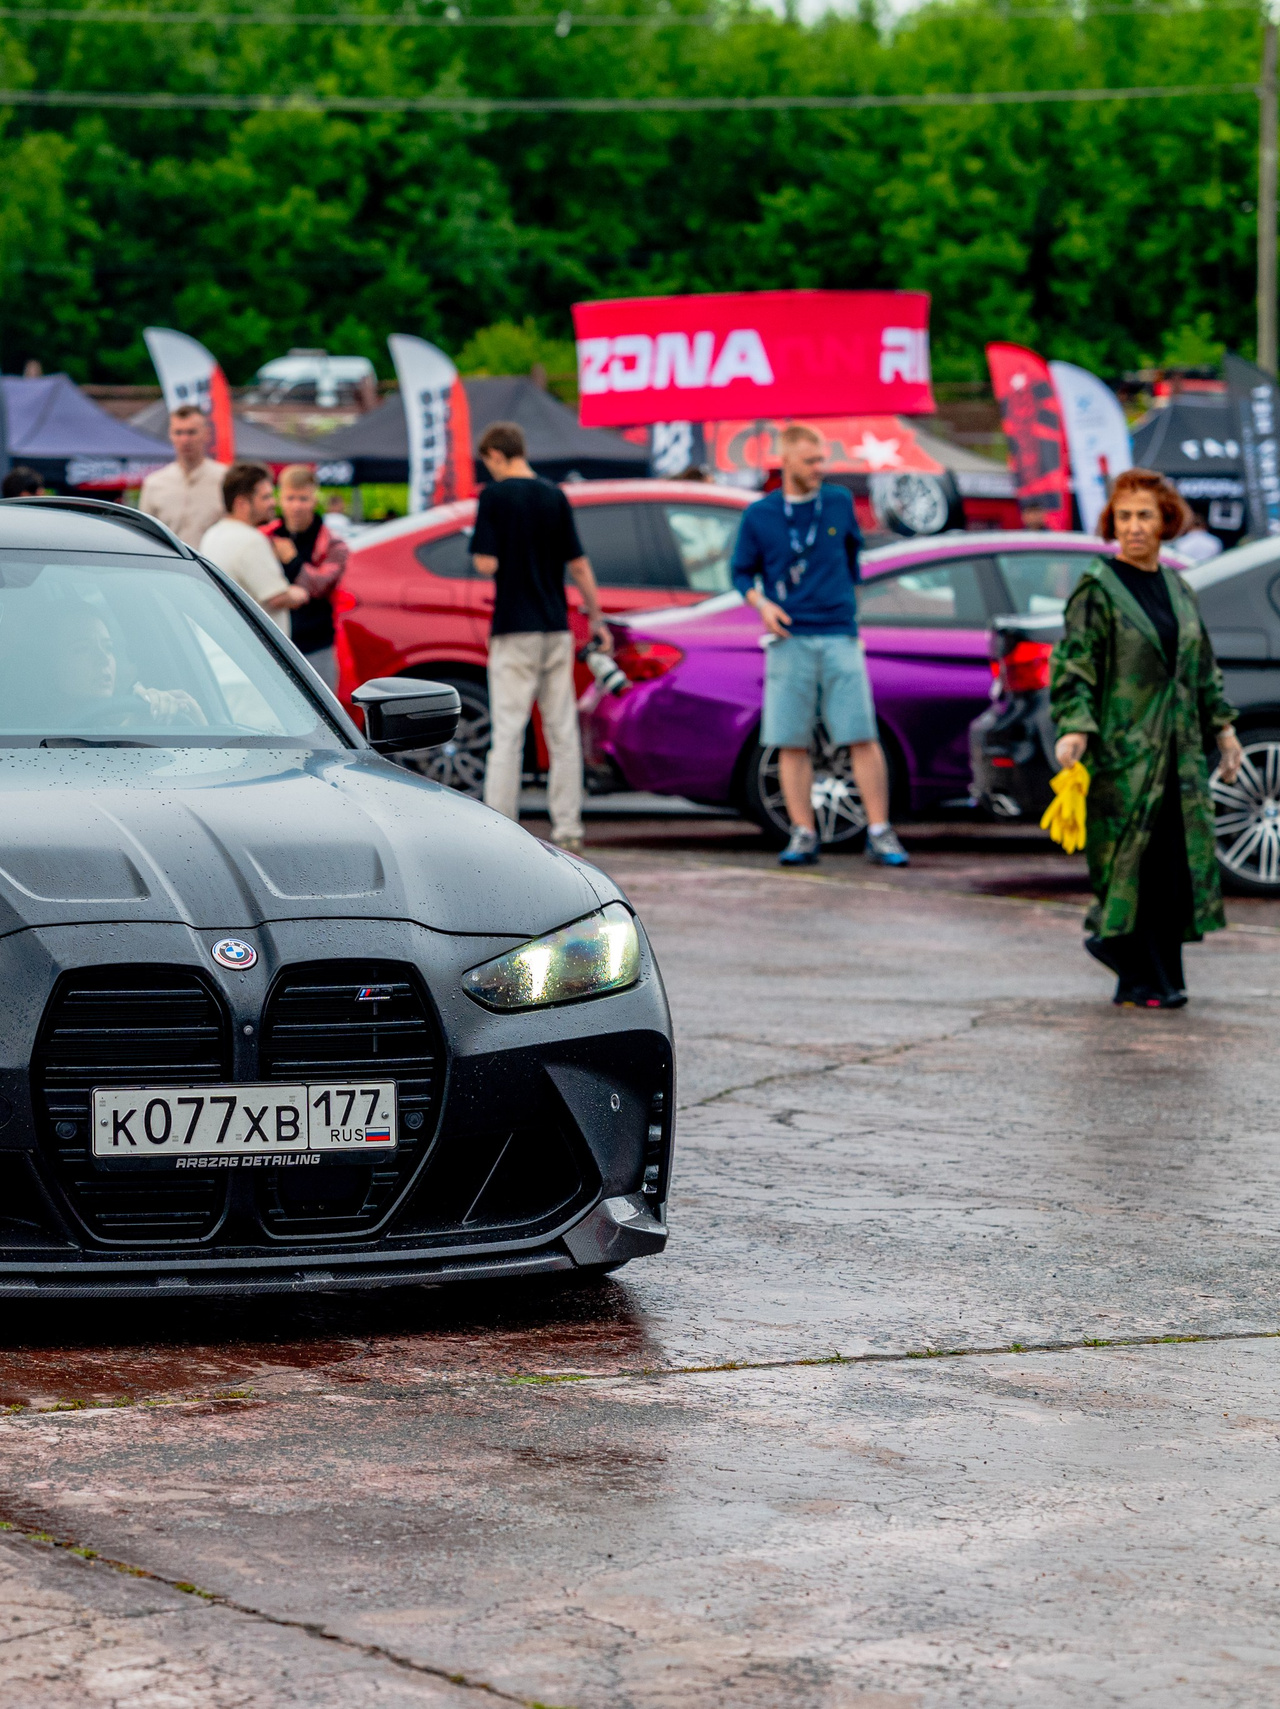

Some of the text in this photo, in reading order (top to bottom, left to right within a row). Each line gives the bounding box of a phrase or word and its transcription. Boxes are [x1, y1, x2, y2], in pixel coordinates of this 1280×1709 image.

[577, 328, 775, 395] ZONA
[112, 1095, 300, 1146] K077XB
[312, 1088, 381, 1127] 177
[330, 1128, 364, 1142] RUS
[175, 1153, 321, 1169] ARSZAG DETAILING
